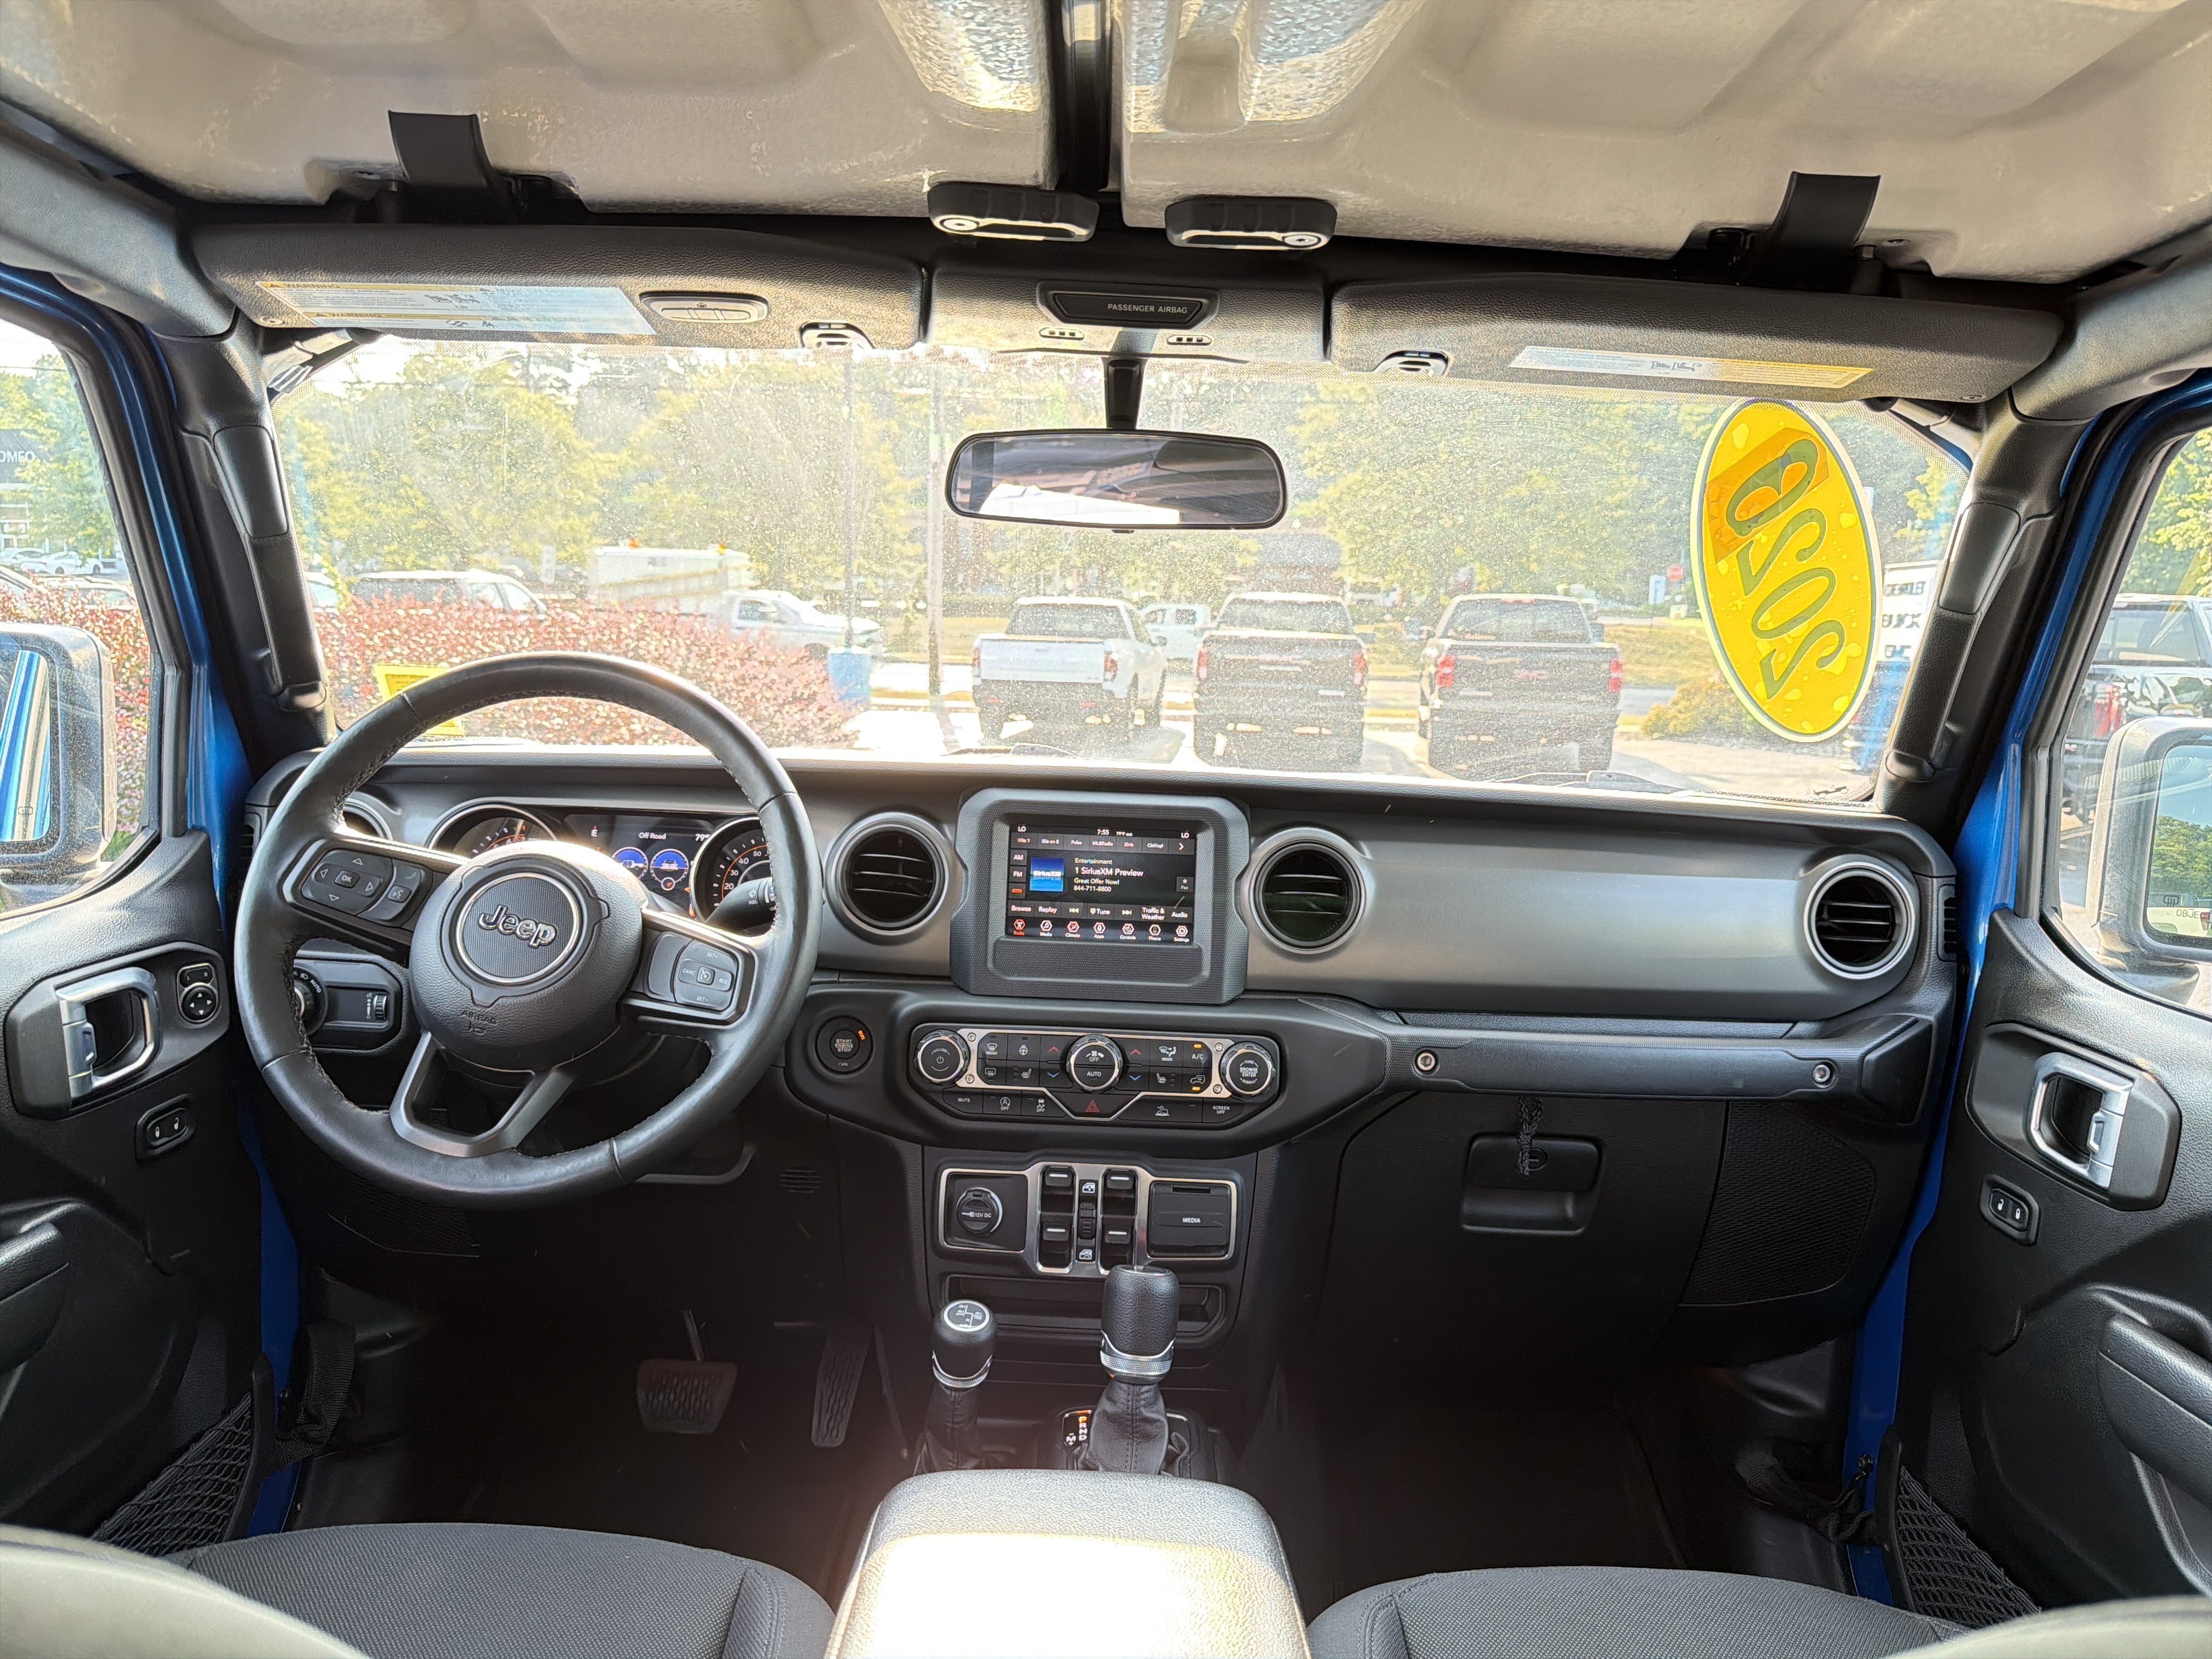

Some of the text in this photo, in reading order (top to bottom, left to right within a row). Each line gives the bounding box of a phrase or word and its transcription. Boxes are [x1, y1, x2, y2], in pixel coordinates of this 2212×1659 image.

[1108, 303, 1188, 314] PASSENGER AIRBAG
[638, 832, 648, 840] Off
[1075, 857, 1113, 865] Entertainment
[1081, 867, 1113, 876] SiriusXM
[1115, 868, 1144, 877] Preview
[341, 874, 352, 883] OK
[477, 903, 557, 949] Jeep
[309, 979, 322, 994] AUTO
[460, 1009, 498, 1026] AIRBAG
